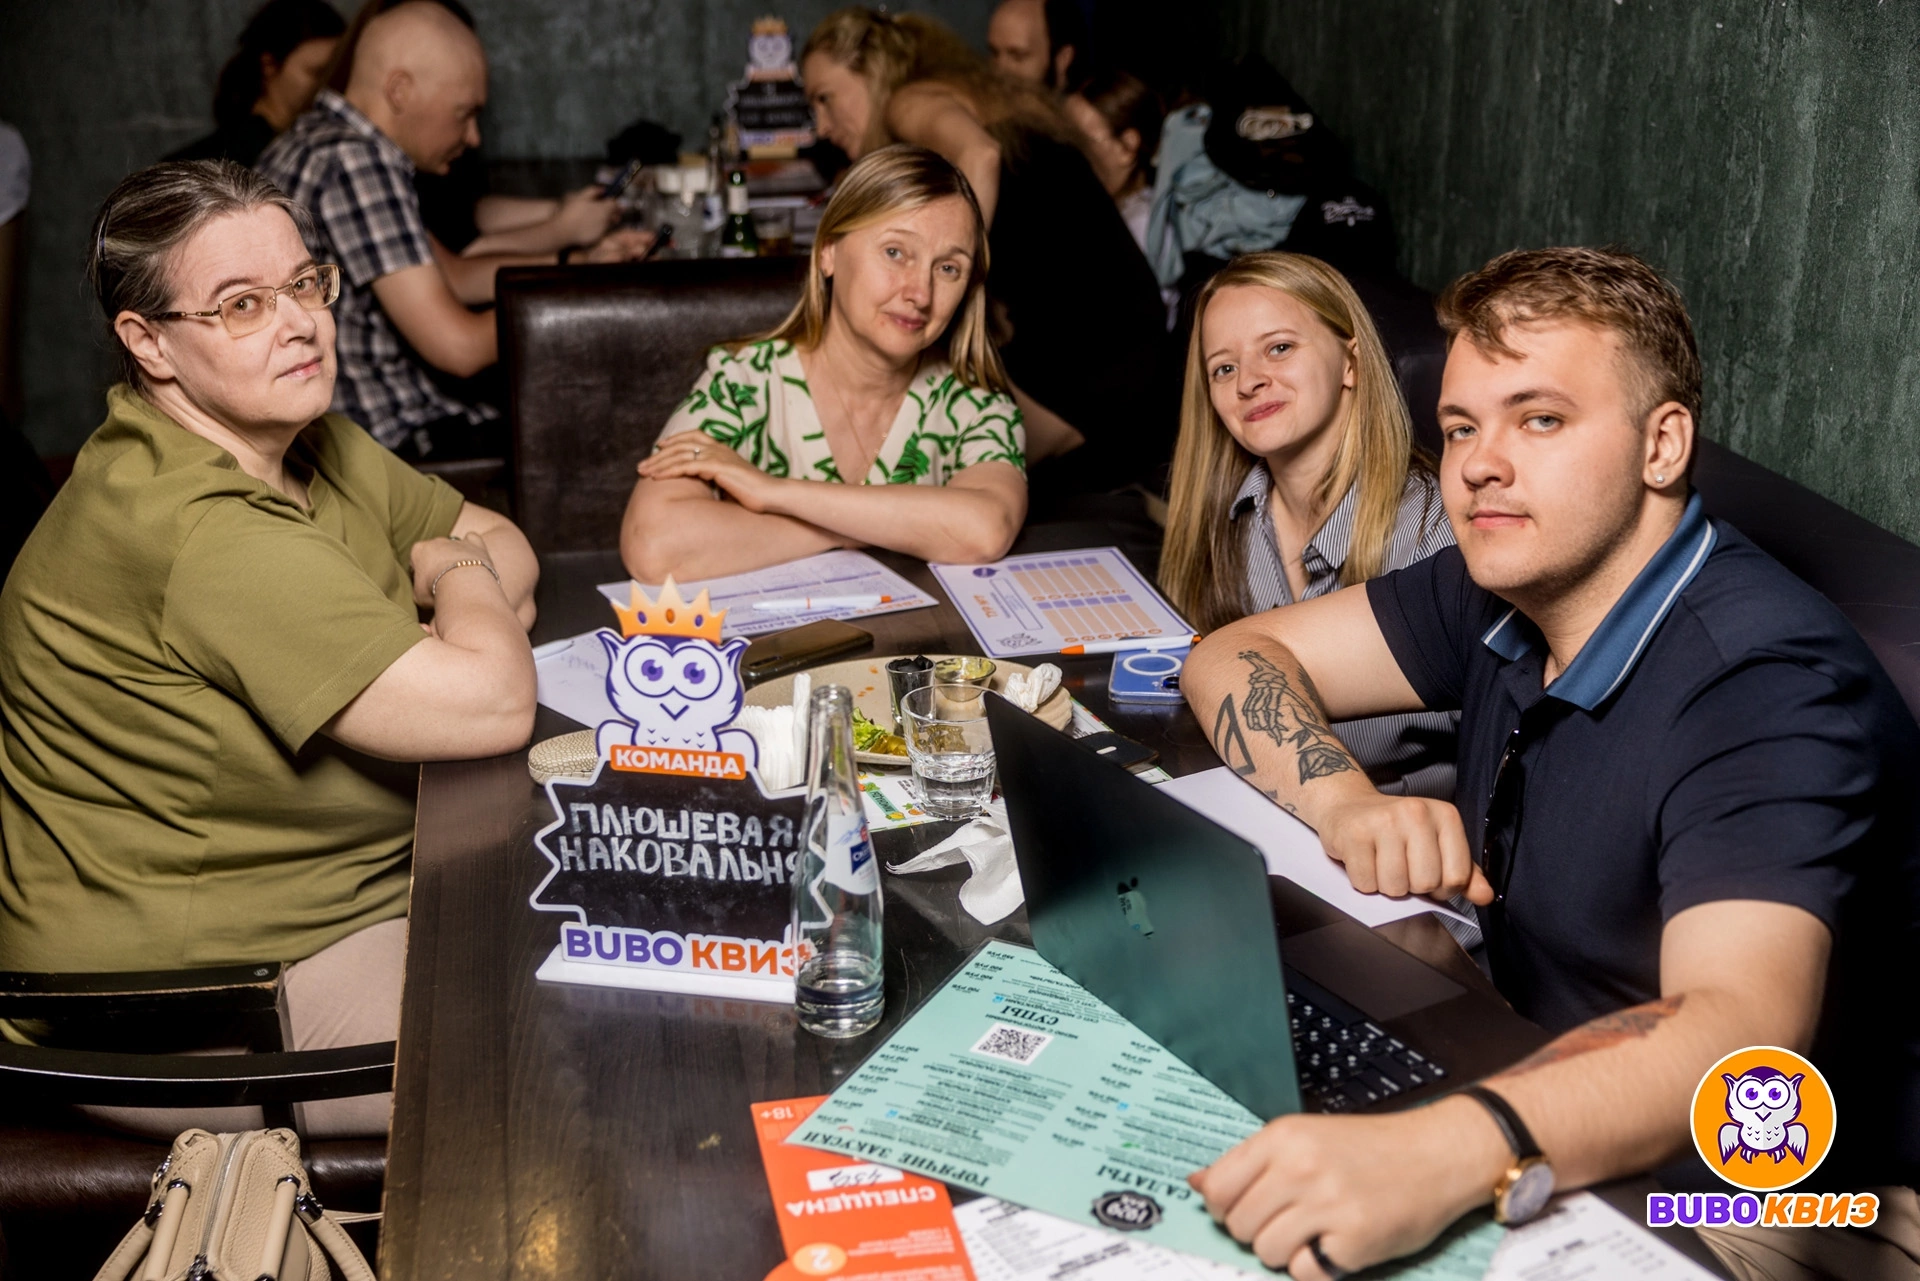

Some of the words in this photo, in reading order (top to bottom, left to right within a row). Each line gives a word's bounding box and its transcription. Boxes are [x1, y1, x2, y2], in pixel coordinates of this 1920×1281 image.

[616, 749, 741, 777] КОМАНДА
[569, 802, 794, 847] ПЛЮШЕВАЯ
[566, 928, 683, 966] BUBO
[999, 1004, 1060, 1026] СУПЫ
[1053, 1029, 1078, 1039] МЕНЮ
[760, 1106, 794, 1120] 18+
[802, 1131, 892, 1159] ЗАКУСКИ
[898, 1152, 990, 1188] ГОРЯЧИЕ
[1097, 1165, 1191, 1200] САЛАТЫ
[785, 1185, 937, 1217] СПЕЦЦЕНА
[808, 1247, 833, 1271] 2
